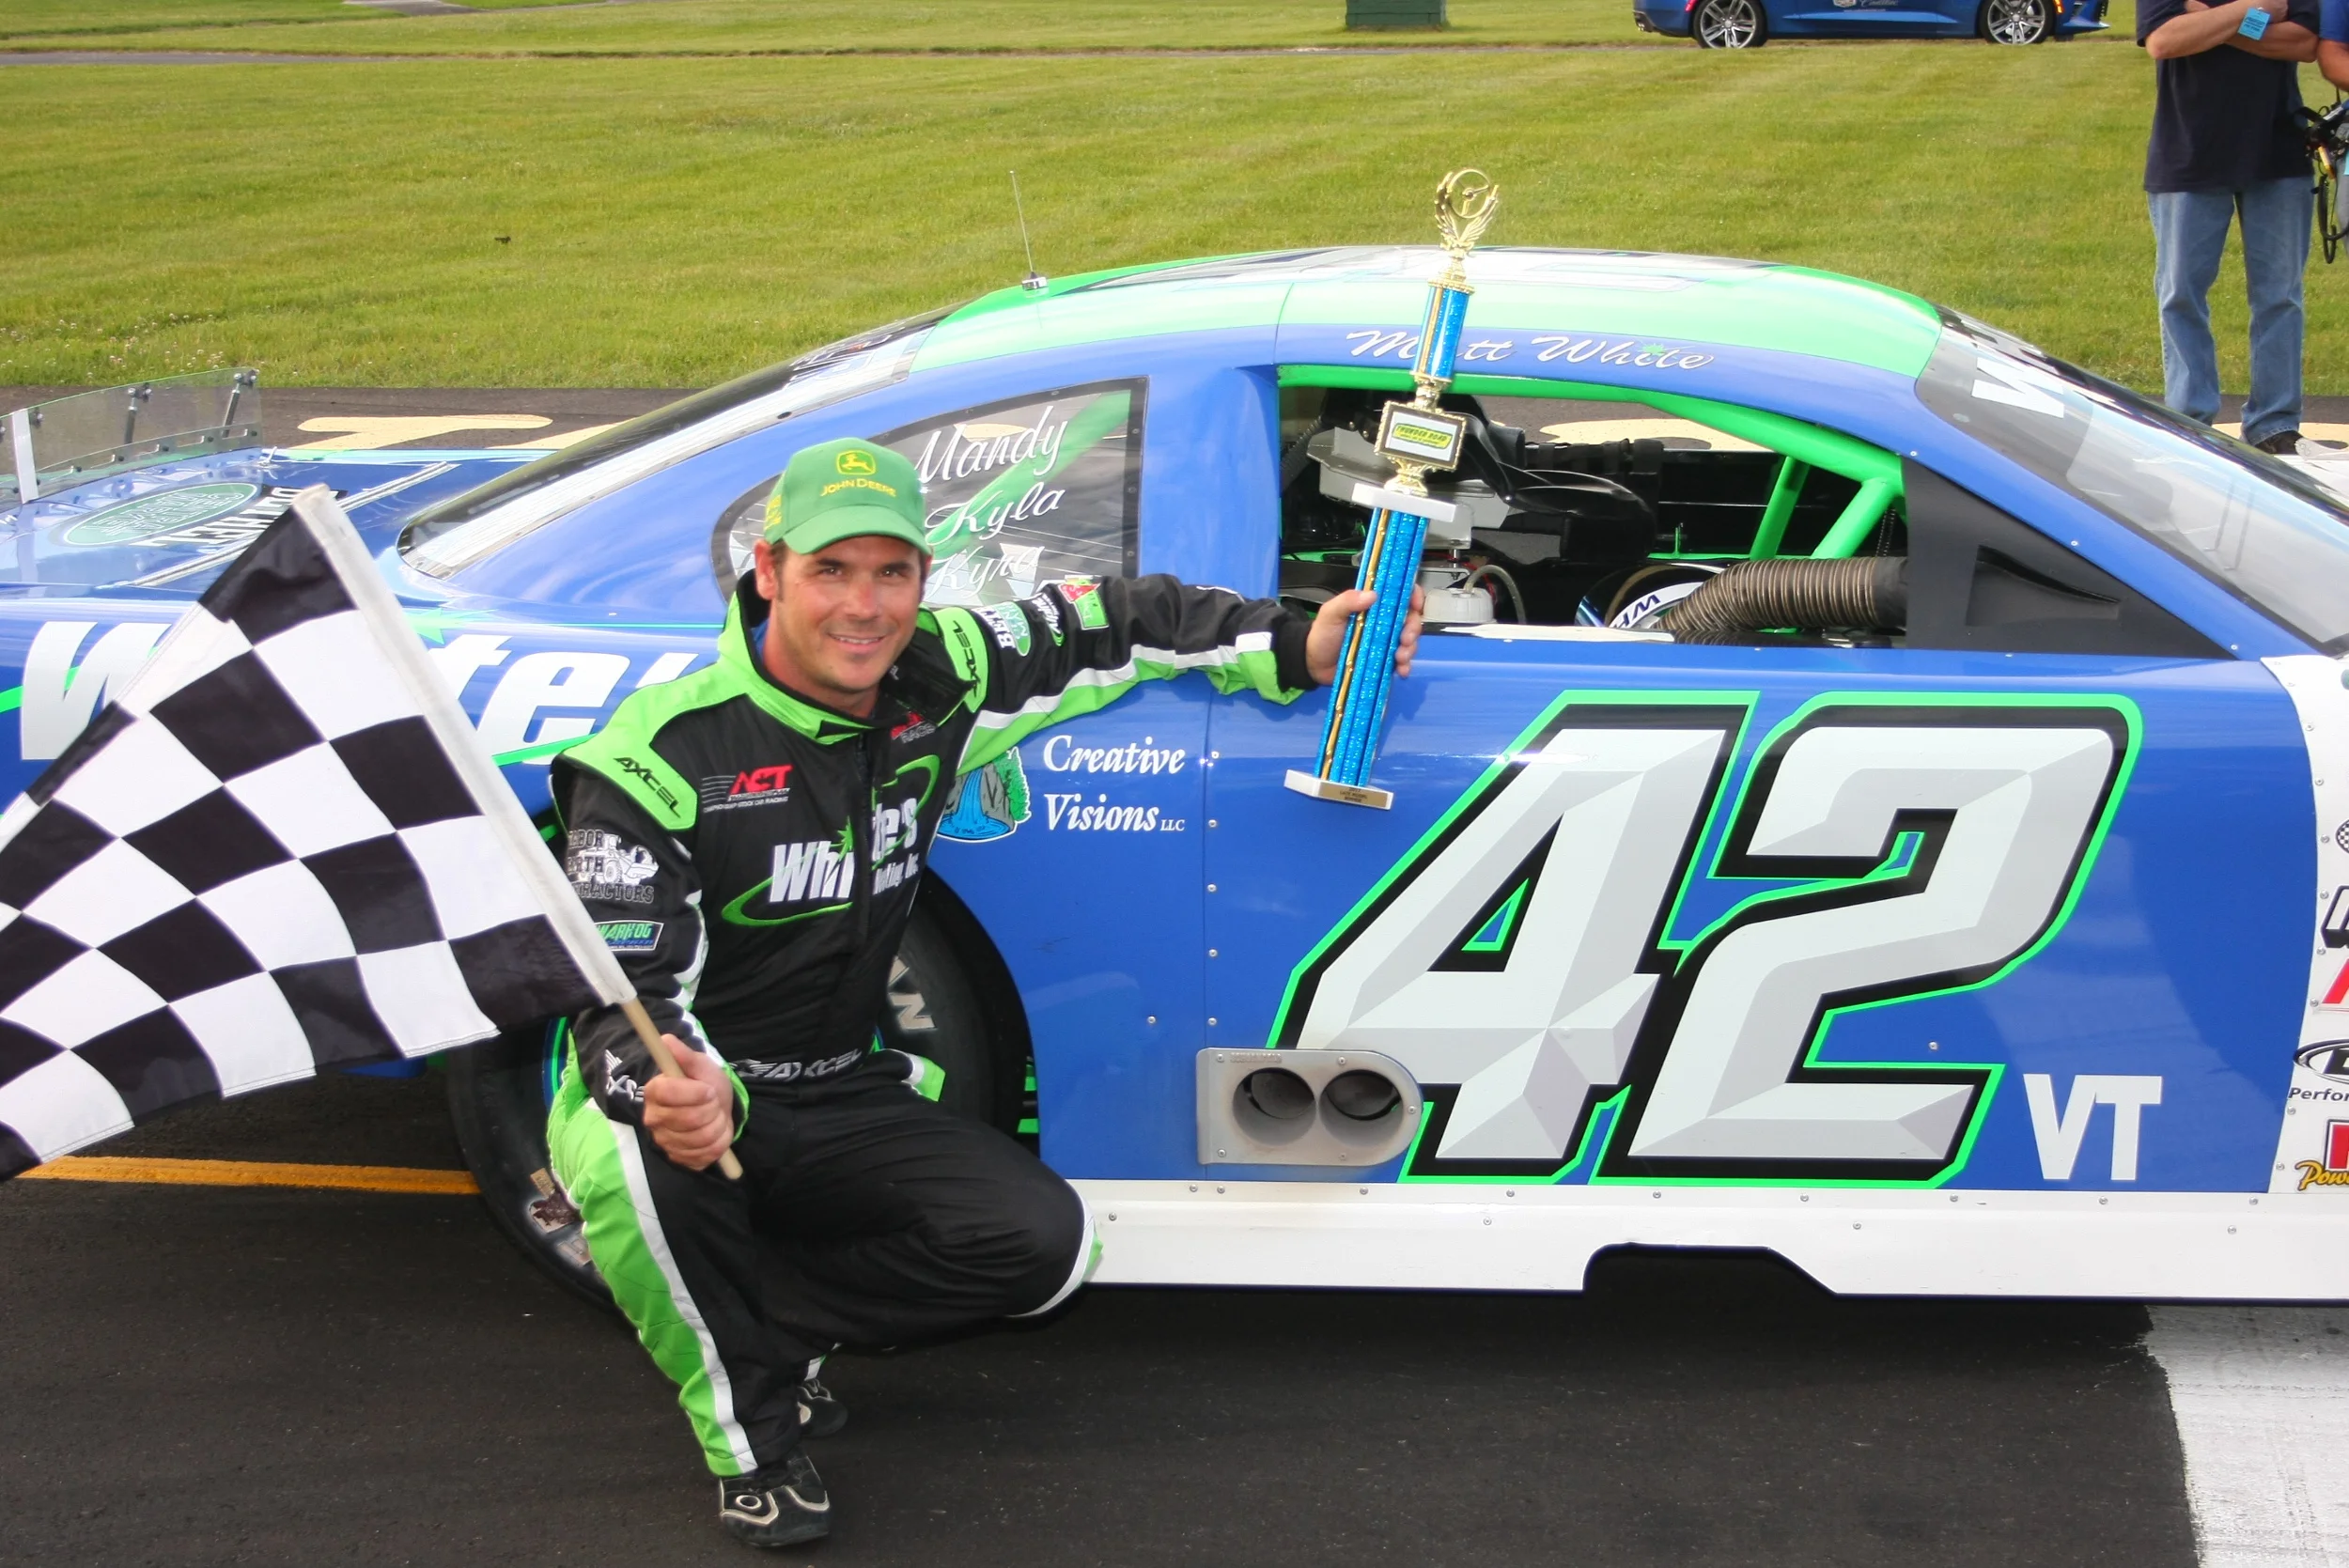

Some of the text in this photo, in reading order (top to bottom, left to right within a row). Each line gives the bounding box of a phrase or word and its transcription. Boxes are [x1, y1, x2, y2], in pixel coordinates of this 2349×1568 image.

[1346, 329, 1715, 370] Mtt White
[913, 405, 1068, 484] Mandy
[925, 482, 1065, 546] Kyla
[1042, 734, 1187, 777] Creative
[614, 756, 681, 820] AXCEL
[1043, 792, 1186, 833] Visions LLC
[1267, 689, 2143, 1188] 42
[2023, 1073, 2162, 1180] VT
